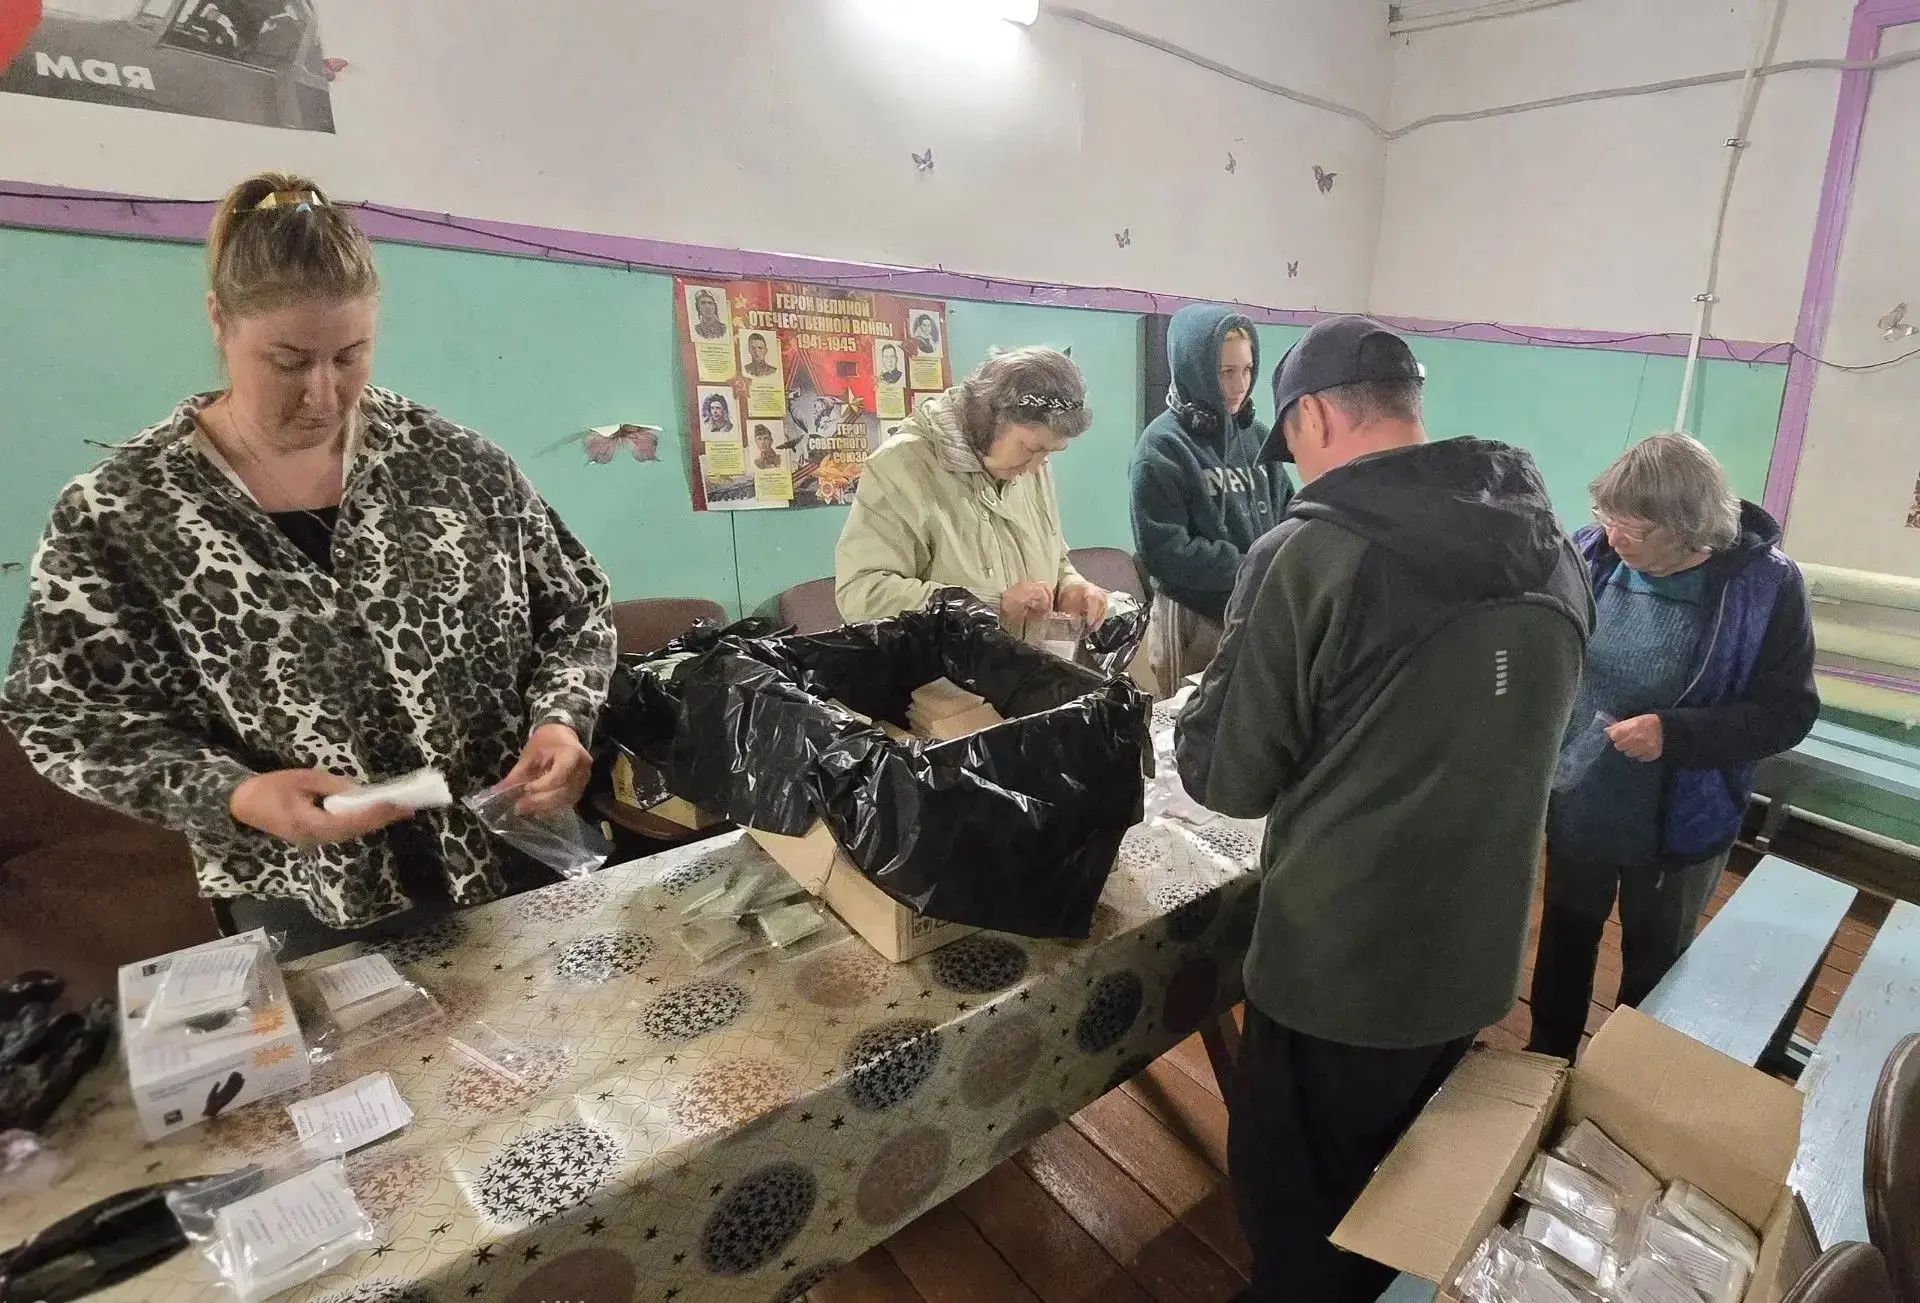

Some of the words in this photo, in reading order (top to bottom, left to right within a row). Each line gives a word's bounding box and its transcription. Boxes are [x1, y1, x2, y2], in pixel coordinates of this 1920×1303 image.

[776, 293, 814, 311] ГЕРОИ
[815, 298, 870, 317] ВЕЛИКОЙ
[748, 310, 851, 334] ОТЕЧЕСТВЕННОЙ
[852, 318, 893, 337] ВОЙНЫ
[796, 333, 857, 352] 1941-1945
[836, 424, 867, 436] ГЕРОИ
[808, 438, 867, 450] СОВЕТСКОГО
[832, 451, 867, 463] СОЮЗА
